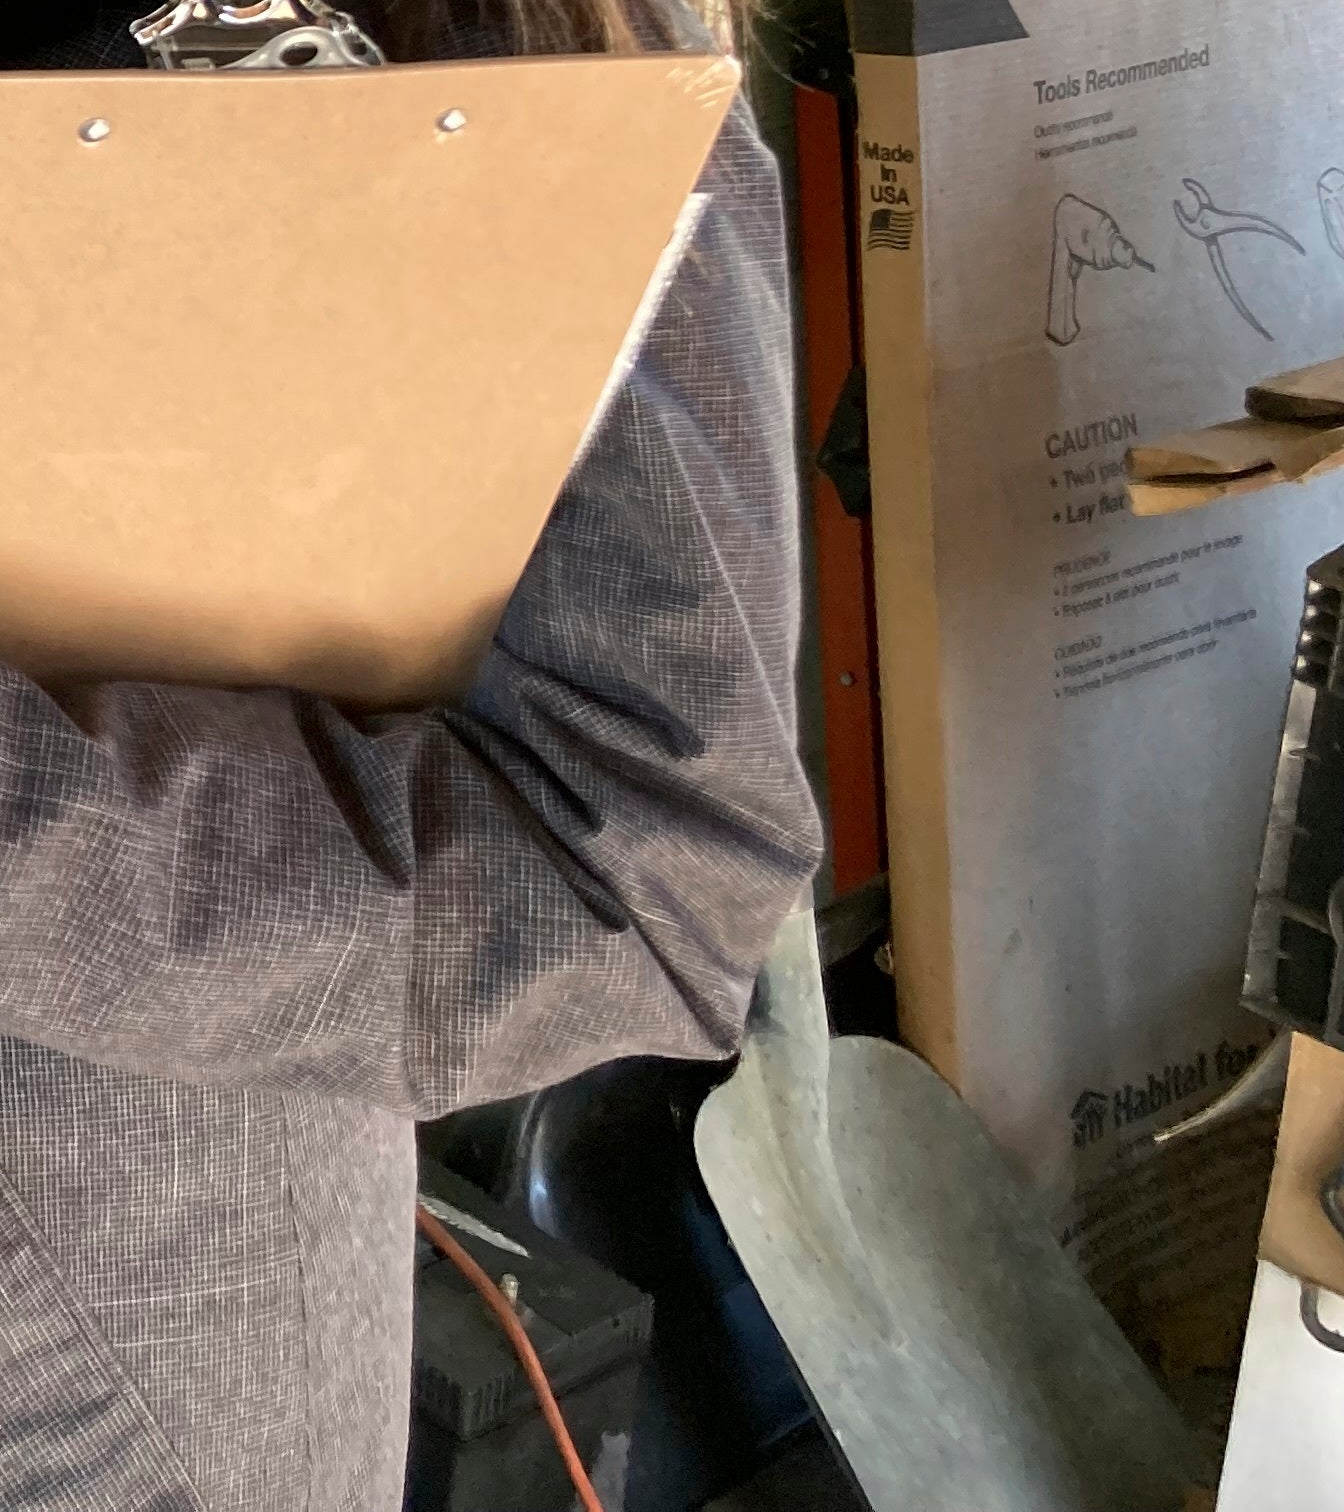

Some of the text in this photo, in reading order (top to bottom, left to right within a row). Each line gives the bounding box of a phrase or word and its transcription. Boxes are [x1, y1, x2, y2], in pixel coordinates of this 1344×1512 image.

[1033, 43, 1210, 105] Tools Recommended
[862, 140, 914, 164] Made
[870, 184, 911, 207] USA
[1044, 412, 1138, 459] CAUTION
[1065, 502, 1096, 525] Lay
